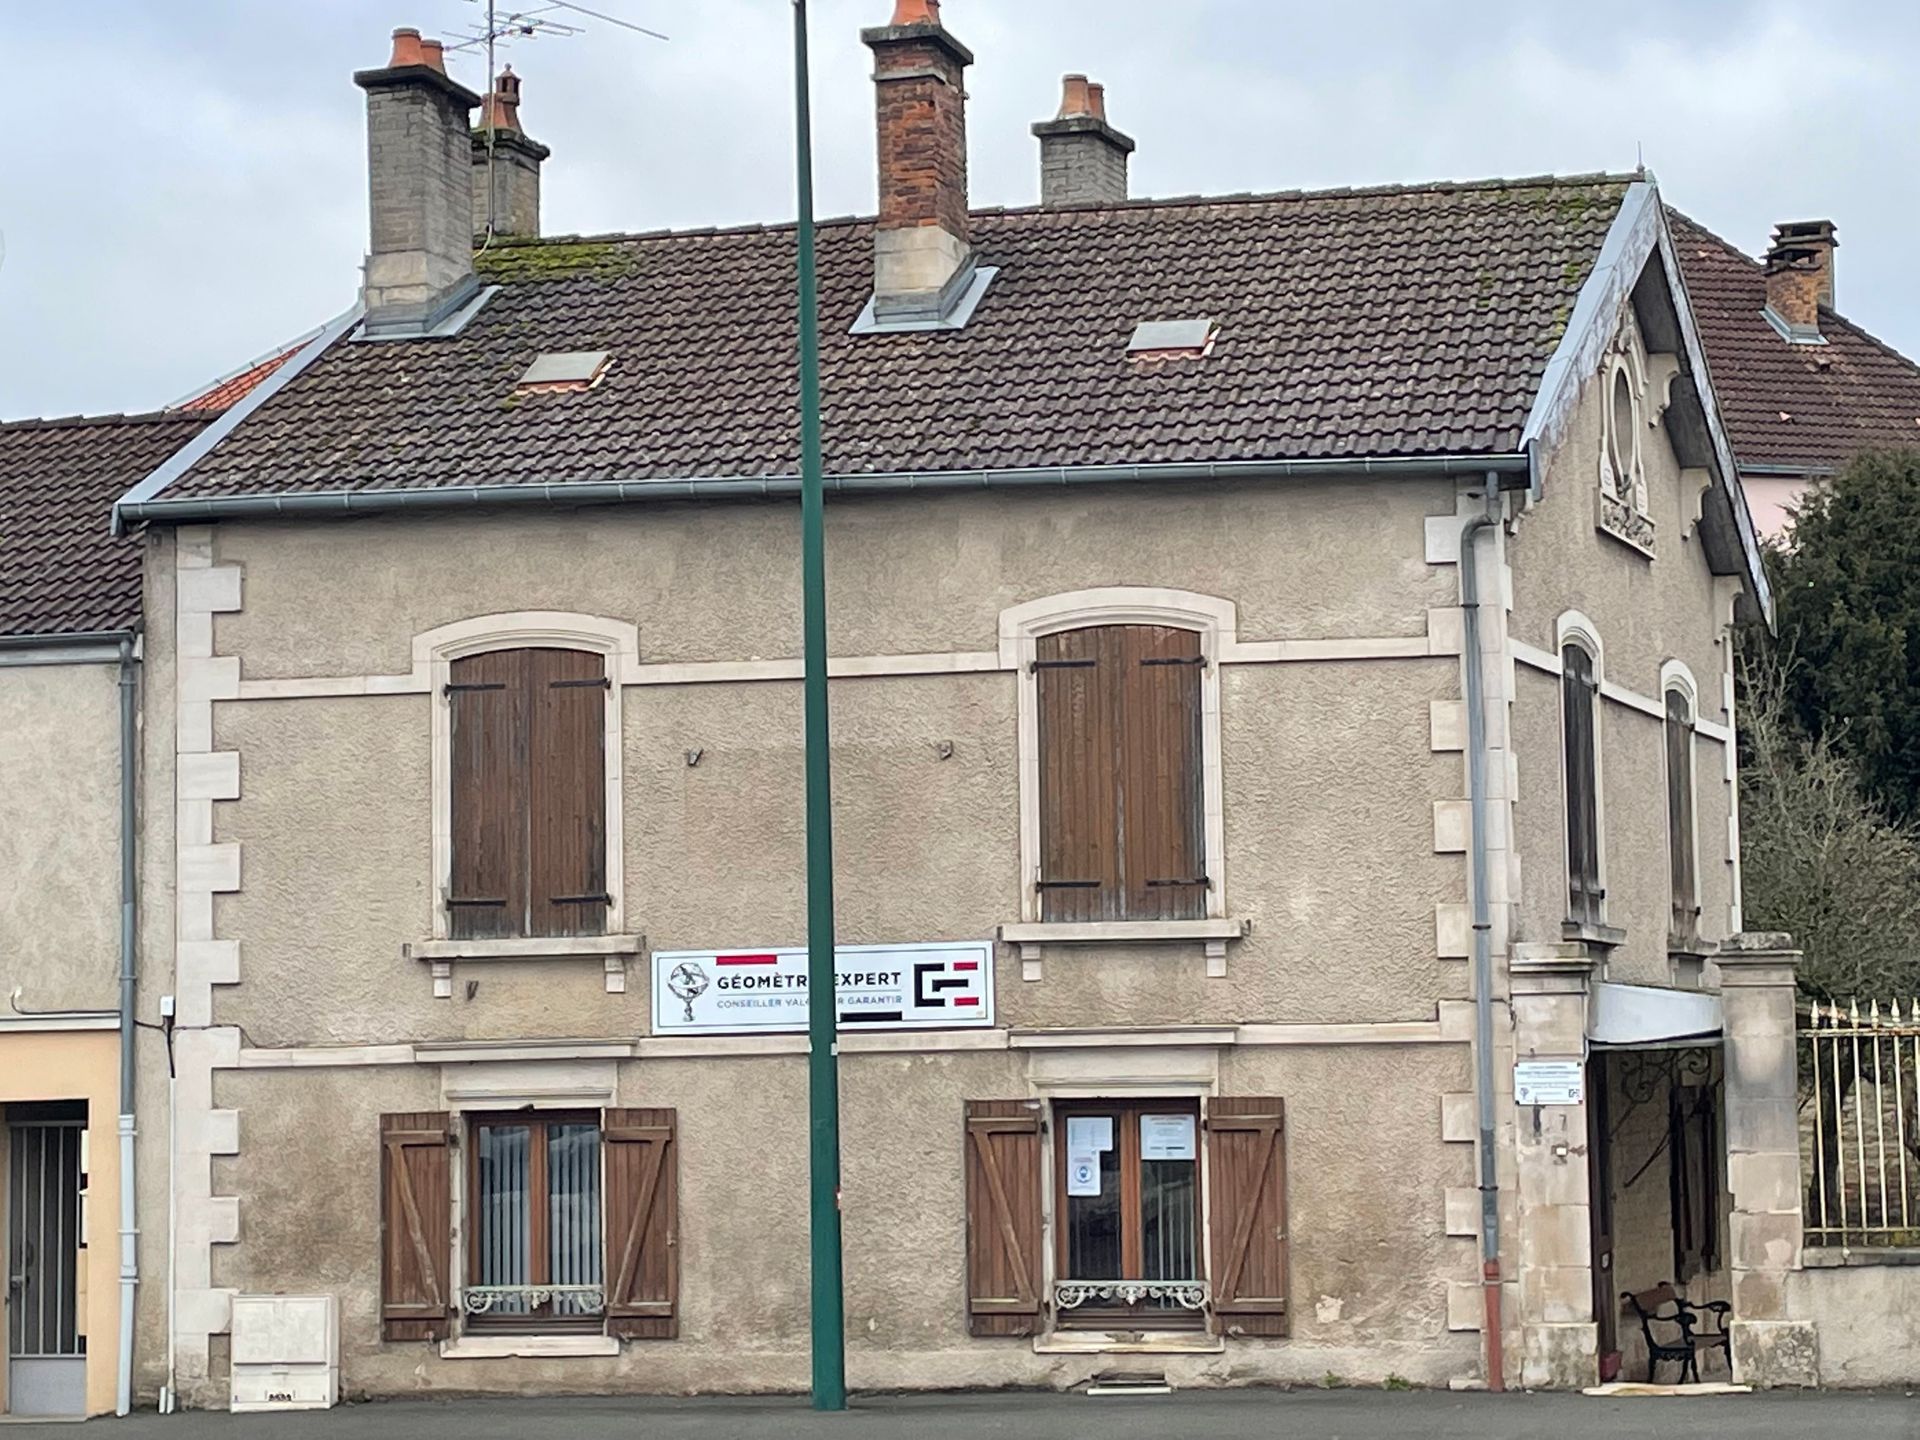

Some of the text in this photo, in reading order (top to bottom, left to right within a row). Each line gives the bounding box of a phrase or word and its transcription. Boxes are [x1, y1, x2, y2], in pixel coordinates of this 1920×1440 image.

[717, 972, 808, 990] GÉOMÈTR
[717, 998, 782, 1009] CONSEILLER
[847, 995, 902, 1005] GARANTIR
